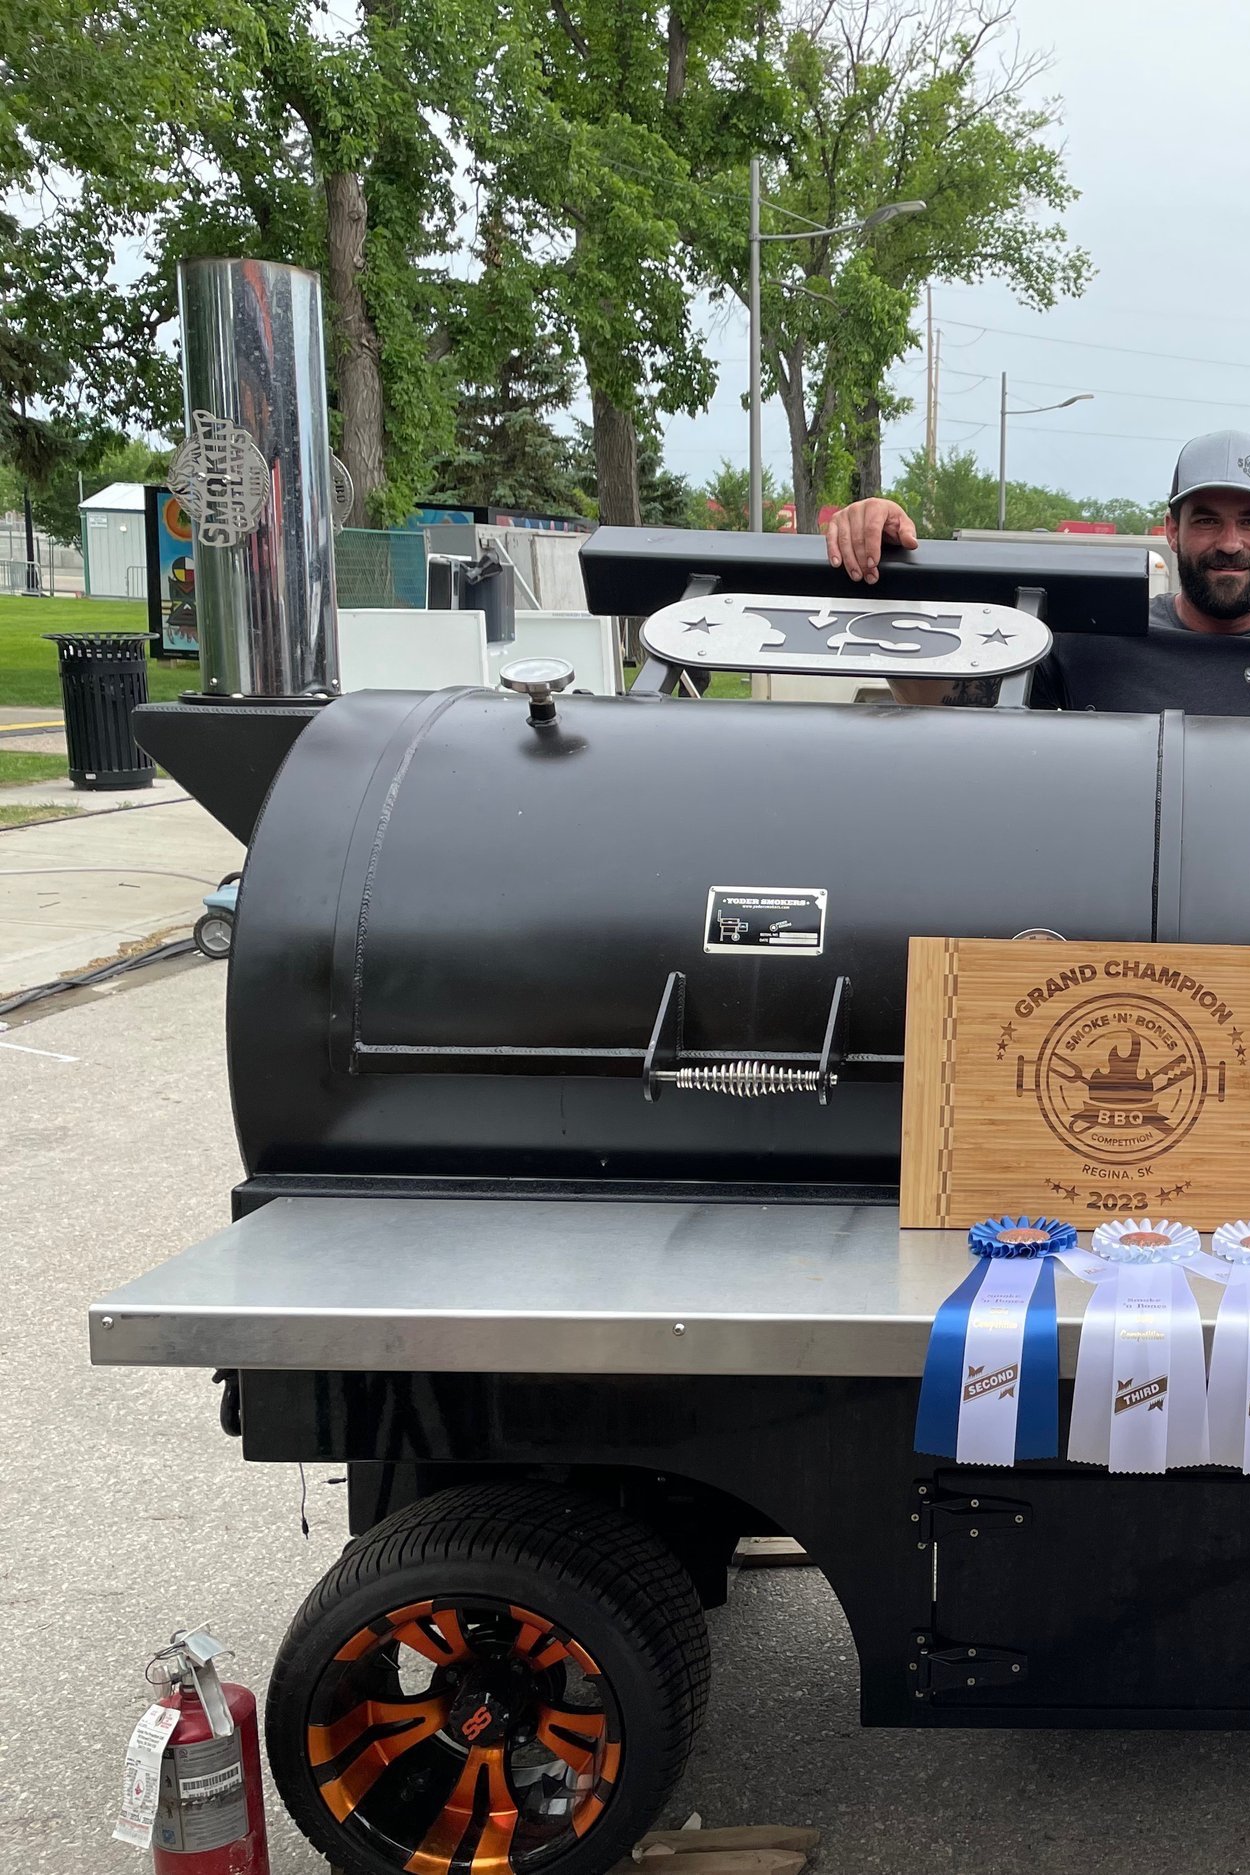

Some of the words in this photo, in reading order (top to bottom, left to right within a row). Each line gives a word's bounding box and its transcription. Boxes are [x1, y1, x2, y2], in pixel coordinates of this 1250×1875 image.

[230, 433, 248, 529] OUTLAWS
[742, 606, 964, 659] YS
[726, 897, 759, 905] YODER
[760, 898, 807, 906] SMOKERS
[1014, 963, 1098, 1018] GRAND
[1103, 960, 1234, 1025] CHAMPION
[1065, 1014, 1111, 1052] SMOKE
[1135, 1015, 1178, 1051] BONES
[1097, 1110, 1144, 1126] BBQ
[1091, 1131, 1154, 1147] COMPETITION
[1082, 1164, 1134, 1180] REGINA,
[1137, 1165, 1154, 1178] SK
[1086, 1191, 1149, 1212] 2023
[973, 1318, 1018, 1332] Competition
[1120, 1328, 1166, 1342] Competition
[968, 1369, 1014, 1395] SECOND
[1123, 1383, 1160, 1406] THIRD
[462, 1706, 492, 1741] SS
